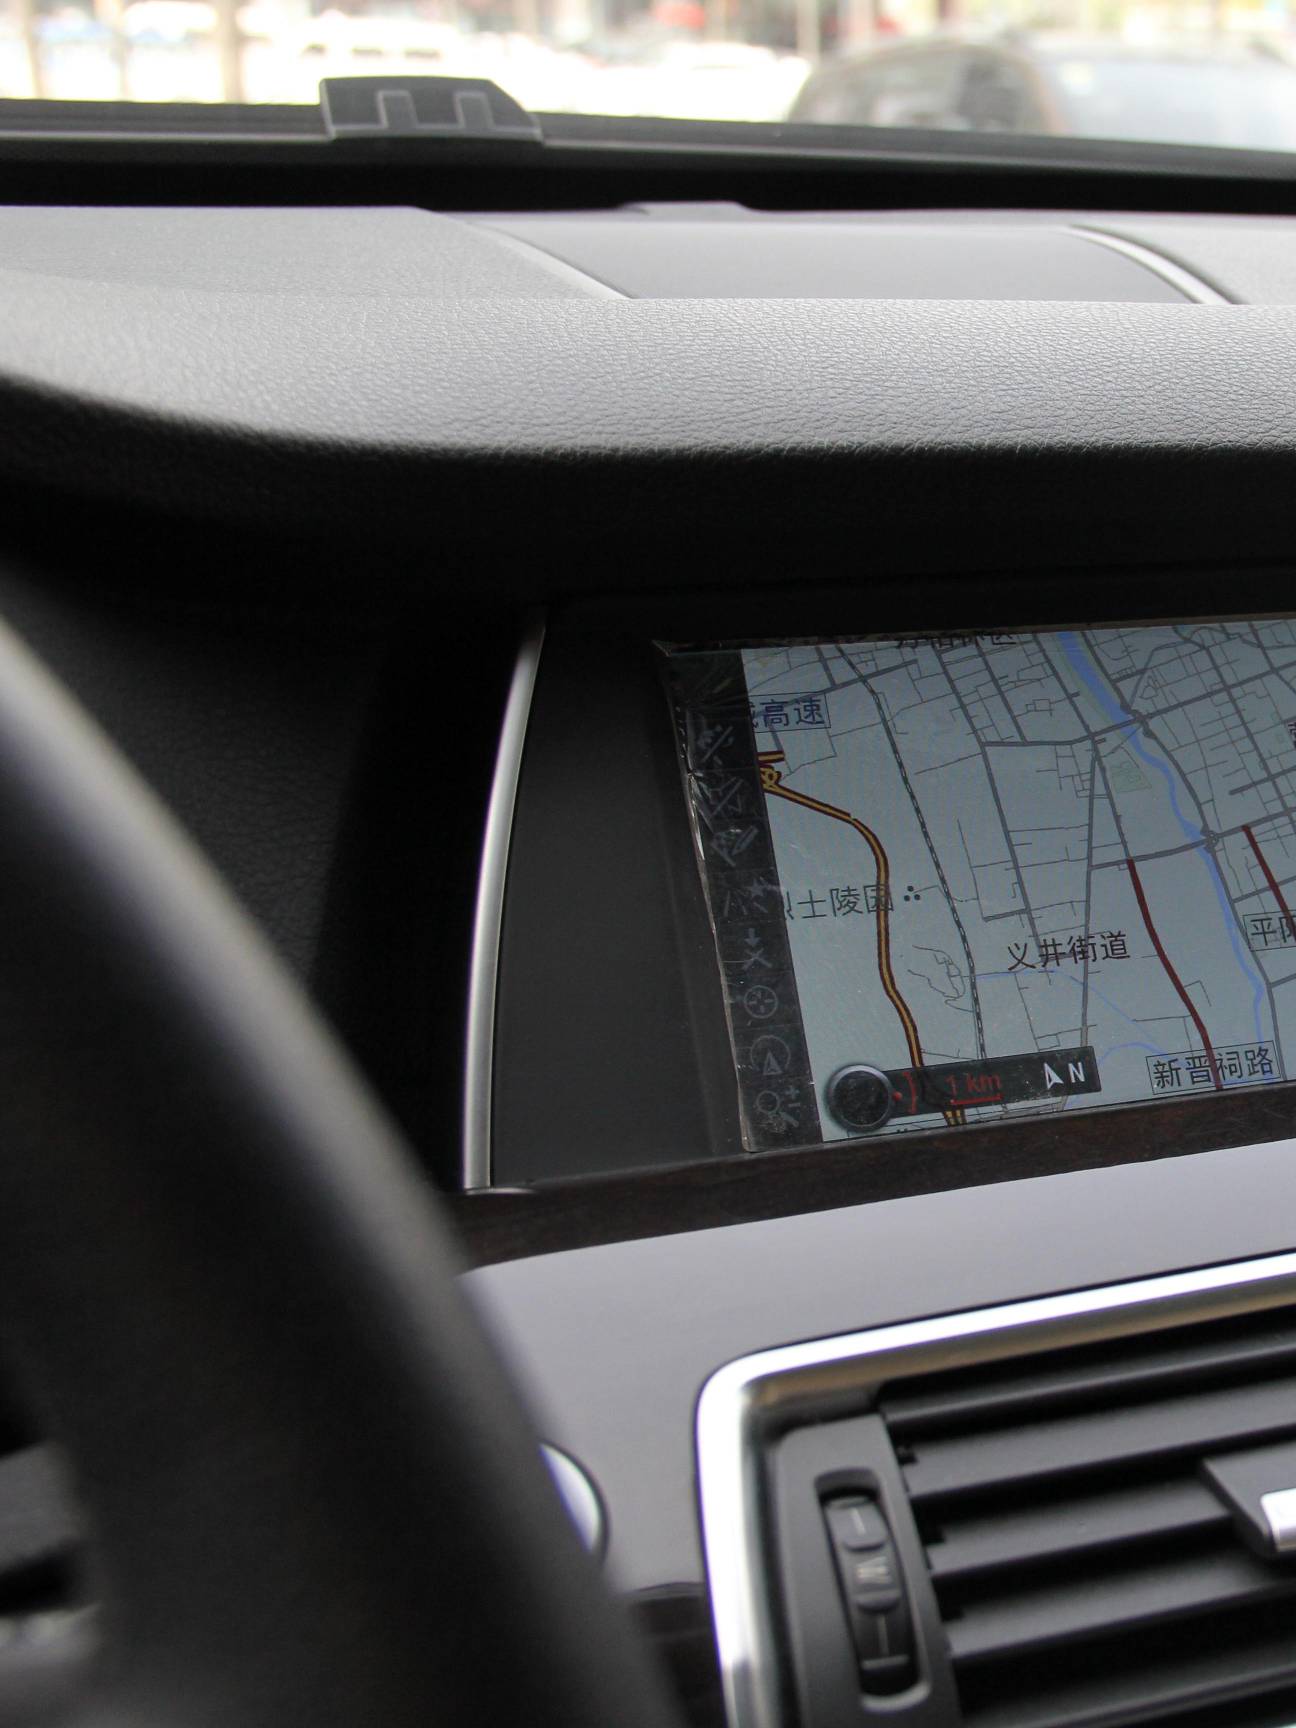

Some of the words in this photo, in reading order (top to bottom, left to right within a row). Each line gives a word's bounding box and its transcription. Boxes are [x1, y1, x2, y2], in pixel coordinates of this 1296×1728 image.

[748, 697, 825, 728] 高速
[784, 883, 894, 919] 士陵园
[1008, 930, 1132, 970] 义井街道
[966, 1073, 1002, 1094] km
[1068, 1061, 1085, 1083] N
[1153, 1046, 1274, 1089] 新晋祠路
